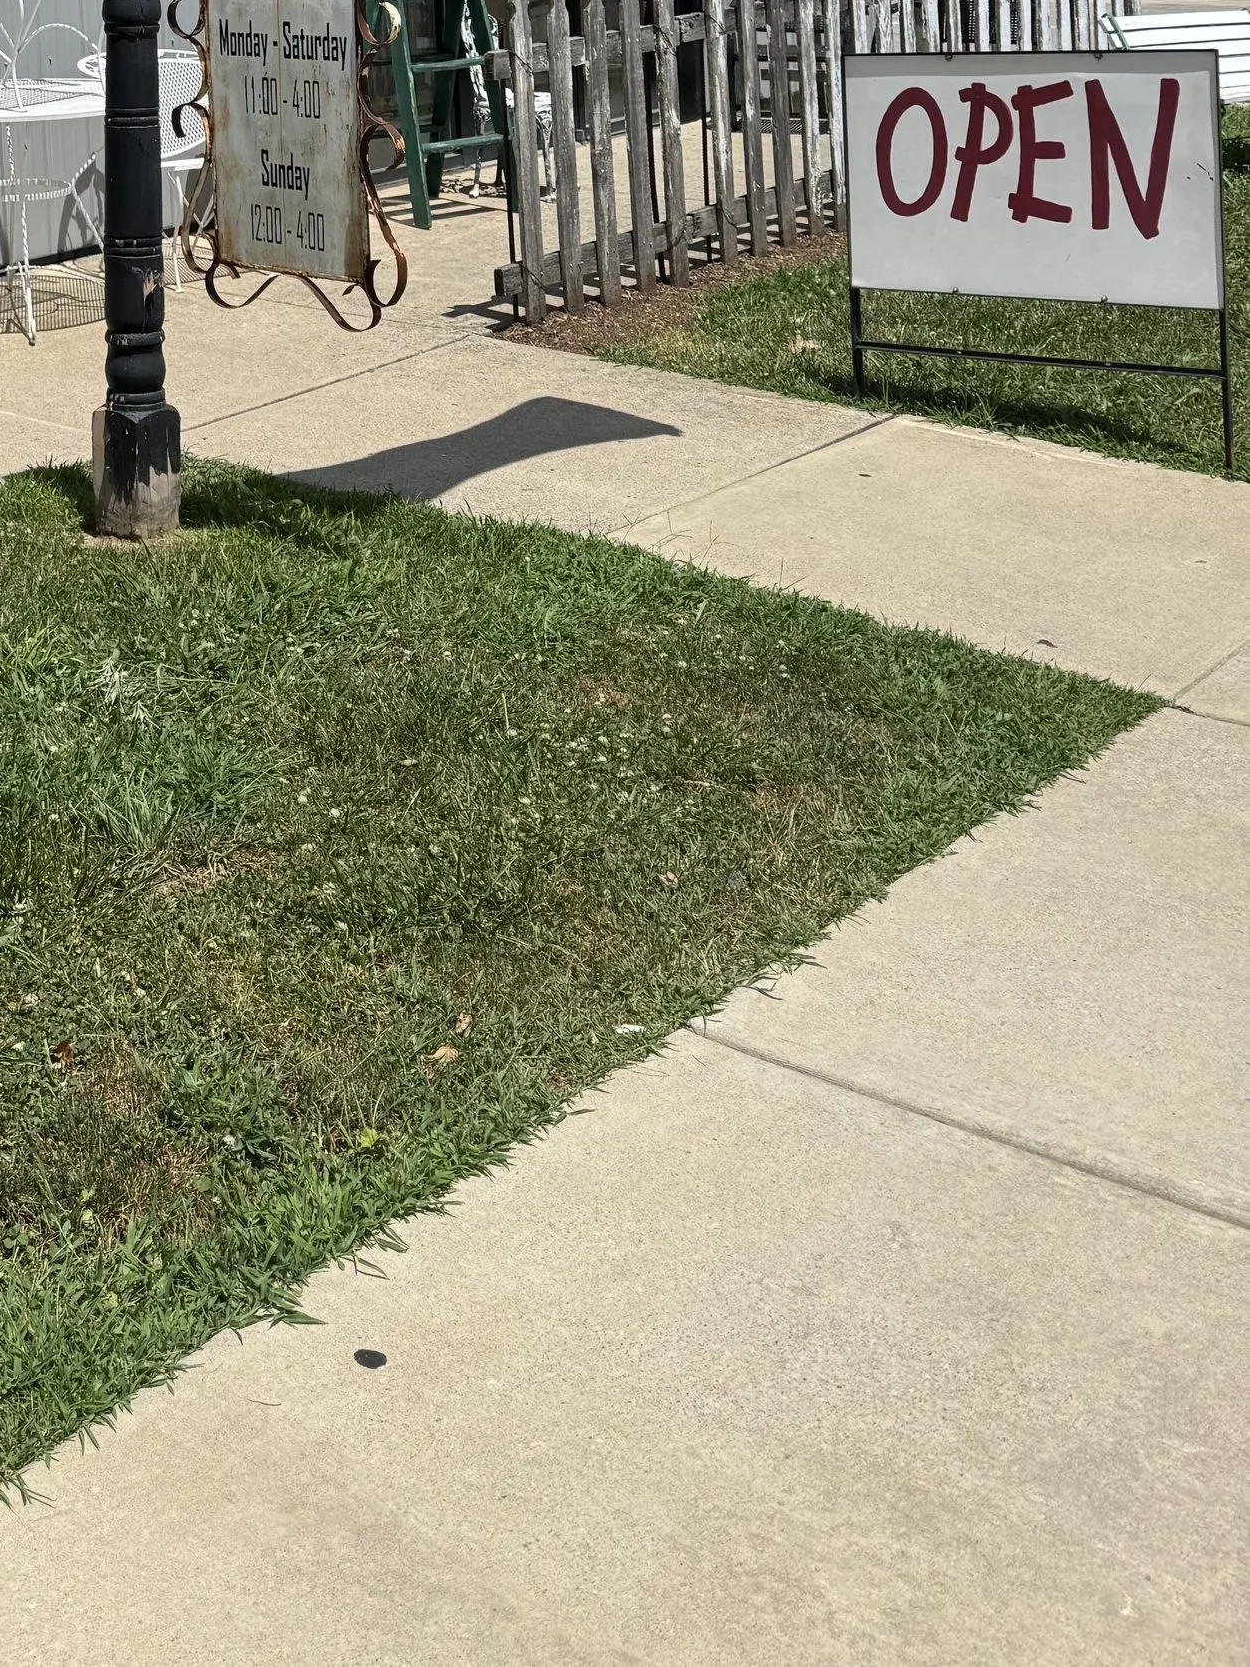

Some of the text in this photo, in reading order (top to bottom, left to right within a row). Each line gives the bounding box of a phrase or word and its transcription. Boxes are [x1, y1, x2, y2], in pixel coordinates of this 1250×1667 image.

[219, 19, 268, 66] Monday
[283, 21, 347, 71] Saturday
[245, 76, 278, 115] 11:00
[292, 79, 321, 119] 4:00
[261, 149, 310, 201] Sunday
[876, 78, 1180, 240] OPEN
[251, 204, 282, 244] 12:00
[297, 211, 325, 251] 4:00
